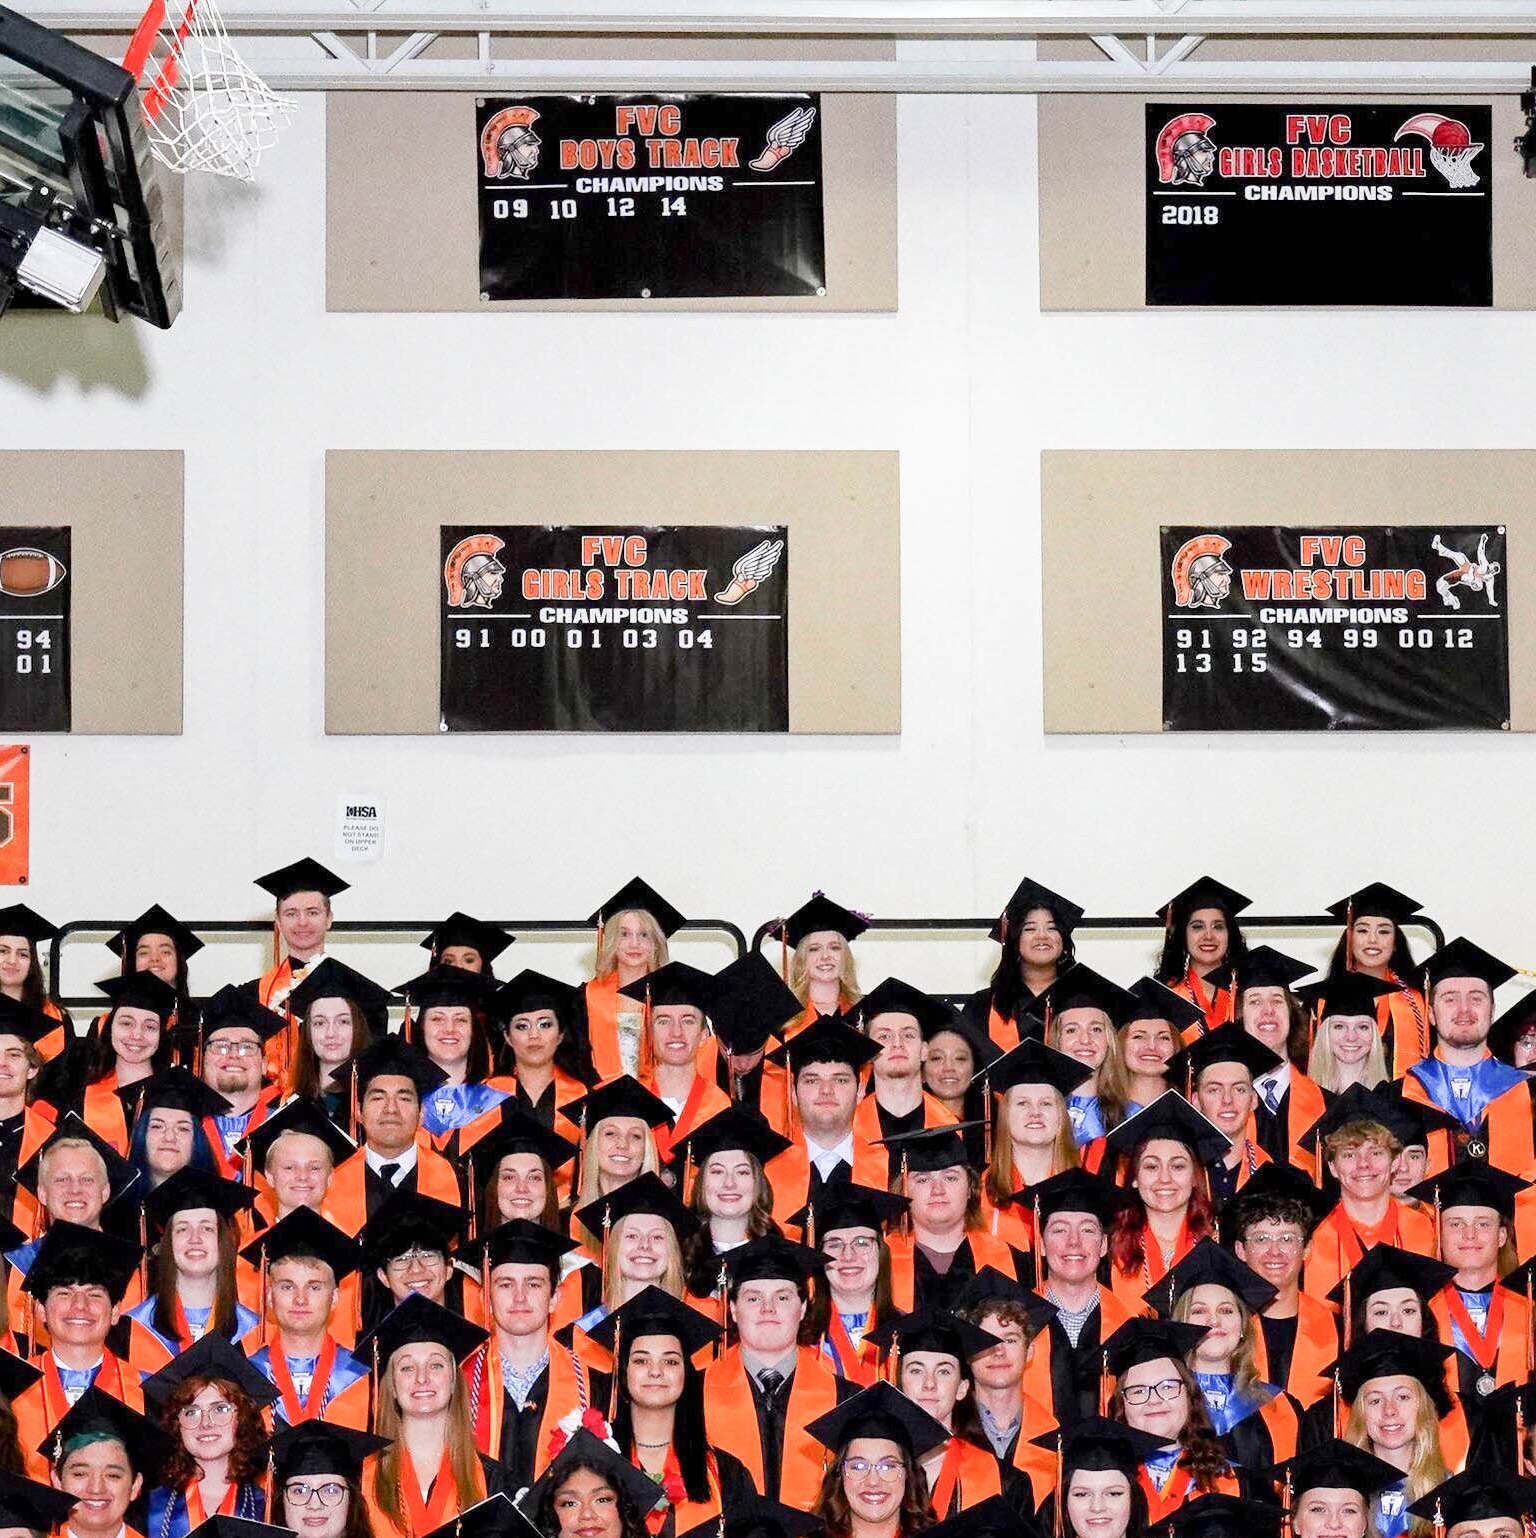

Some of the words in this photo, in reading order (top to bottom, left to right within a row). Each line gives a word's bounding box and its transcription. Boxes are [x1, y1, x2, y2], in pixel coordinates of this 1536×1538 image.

[616, 104, 681, 136] FVC
[1286, 114, 1352, 144] FVC
[560, 139, 635, 169] BOYS
[645, 138, 740, 169] TRACK
[1219, 147, 1282, 178] GIRLS
[1292, 148, 1426, 178] BASKETBALL
[576, 175, 724, 193] CHAMPIONS
[1244, 185, 1393, 201] CHAMPIONS
[494, 199, 529, 219] 09
[550, 199, 577, 219] 10
[607, 197, 635, 217] 12
[661, 197, 687, 217] 14
[1162, 205, 1219, 225] 2018
[581, 536, 647, 567] FVC
[1300, 535, 1366, 568] FVC
[522, 569, 605, 601] GIRLS
[614, 569, 708, 601] TRACK
[1241, 569, 1427, 601] WRESTLING
[539, 607, 689, 624] CHAMPIONS
[1260, 607, 1409, 624] CHAMPIONS
[17, 630, 51, 650] 94
[455, 629, 490, 649] 91
[512, 629, 546, 649] 00
[567, 629, 601, 649] 01
[623, 629, 657, 649] 03
[678, 629, 713, 649] 04
[1176, 629, 1211, 649] 91
[1232, 629, 1267, 649] 92
[1288, 629, 1322, 649] 94
[1343, 629, 1378, 649] 99
[1399, 629, 1434, 649] 00
[1445, 629, 1473, 649] 12
[17, 655, 51, 675] 01
[1176, 653, 1211, 672] 13
[1232, 653, 1267, 672] 15
